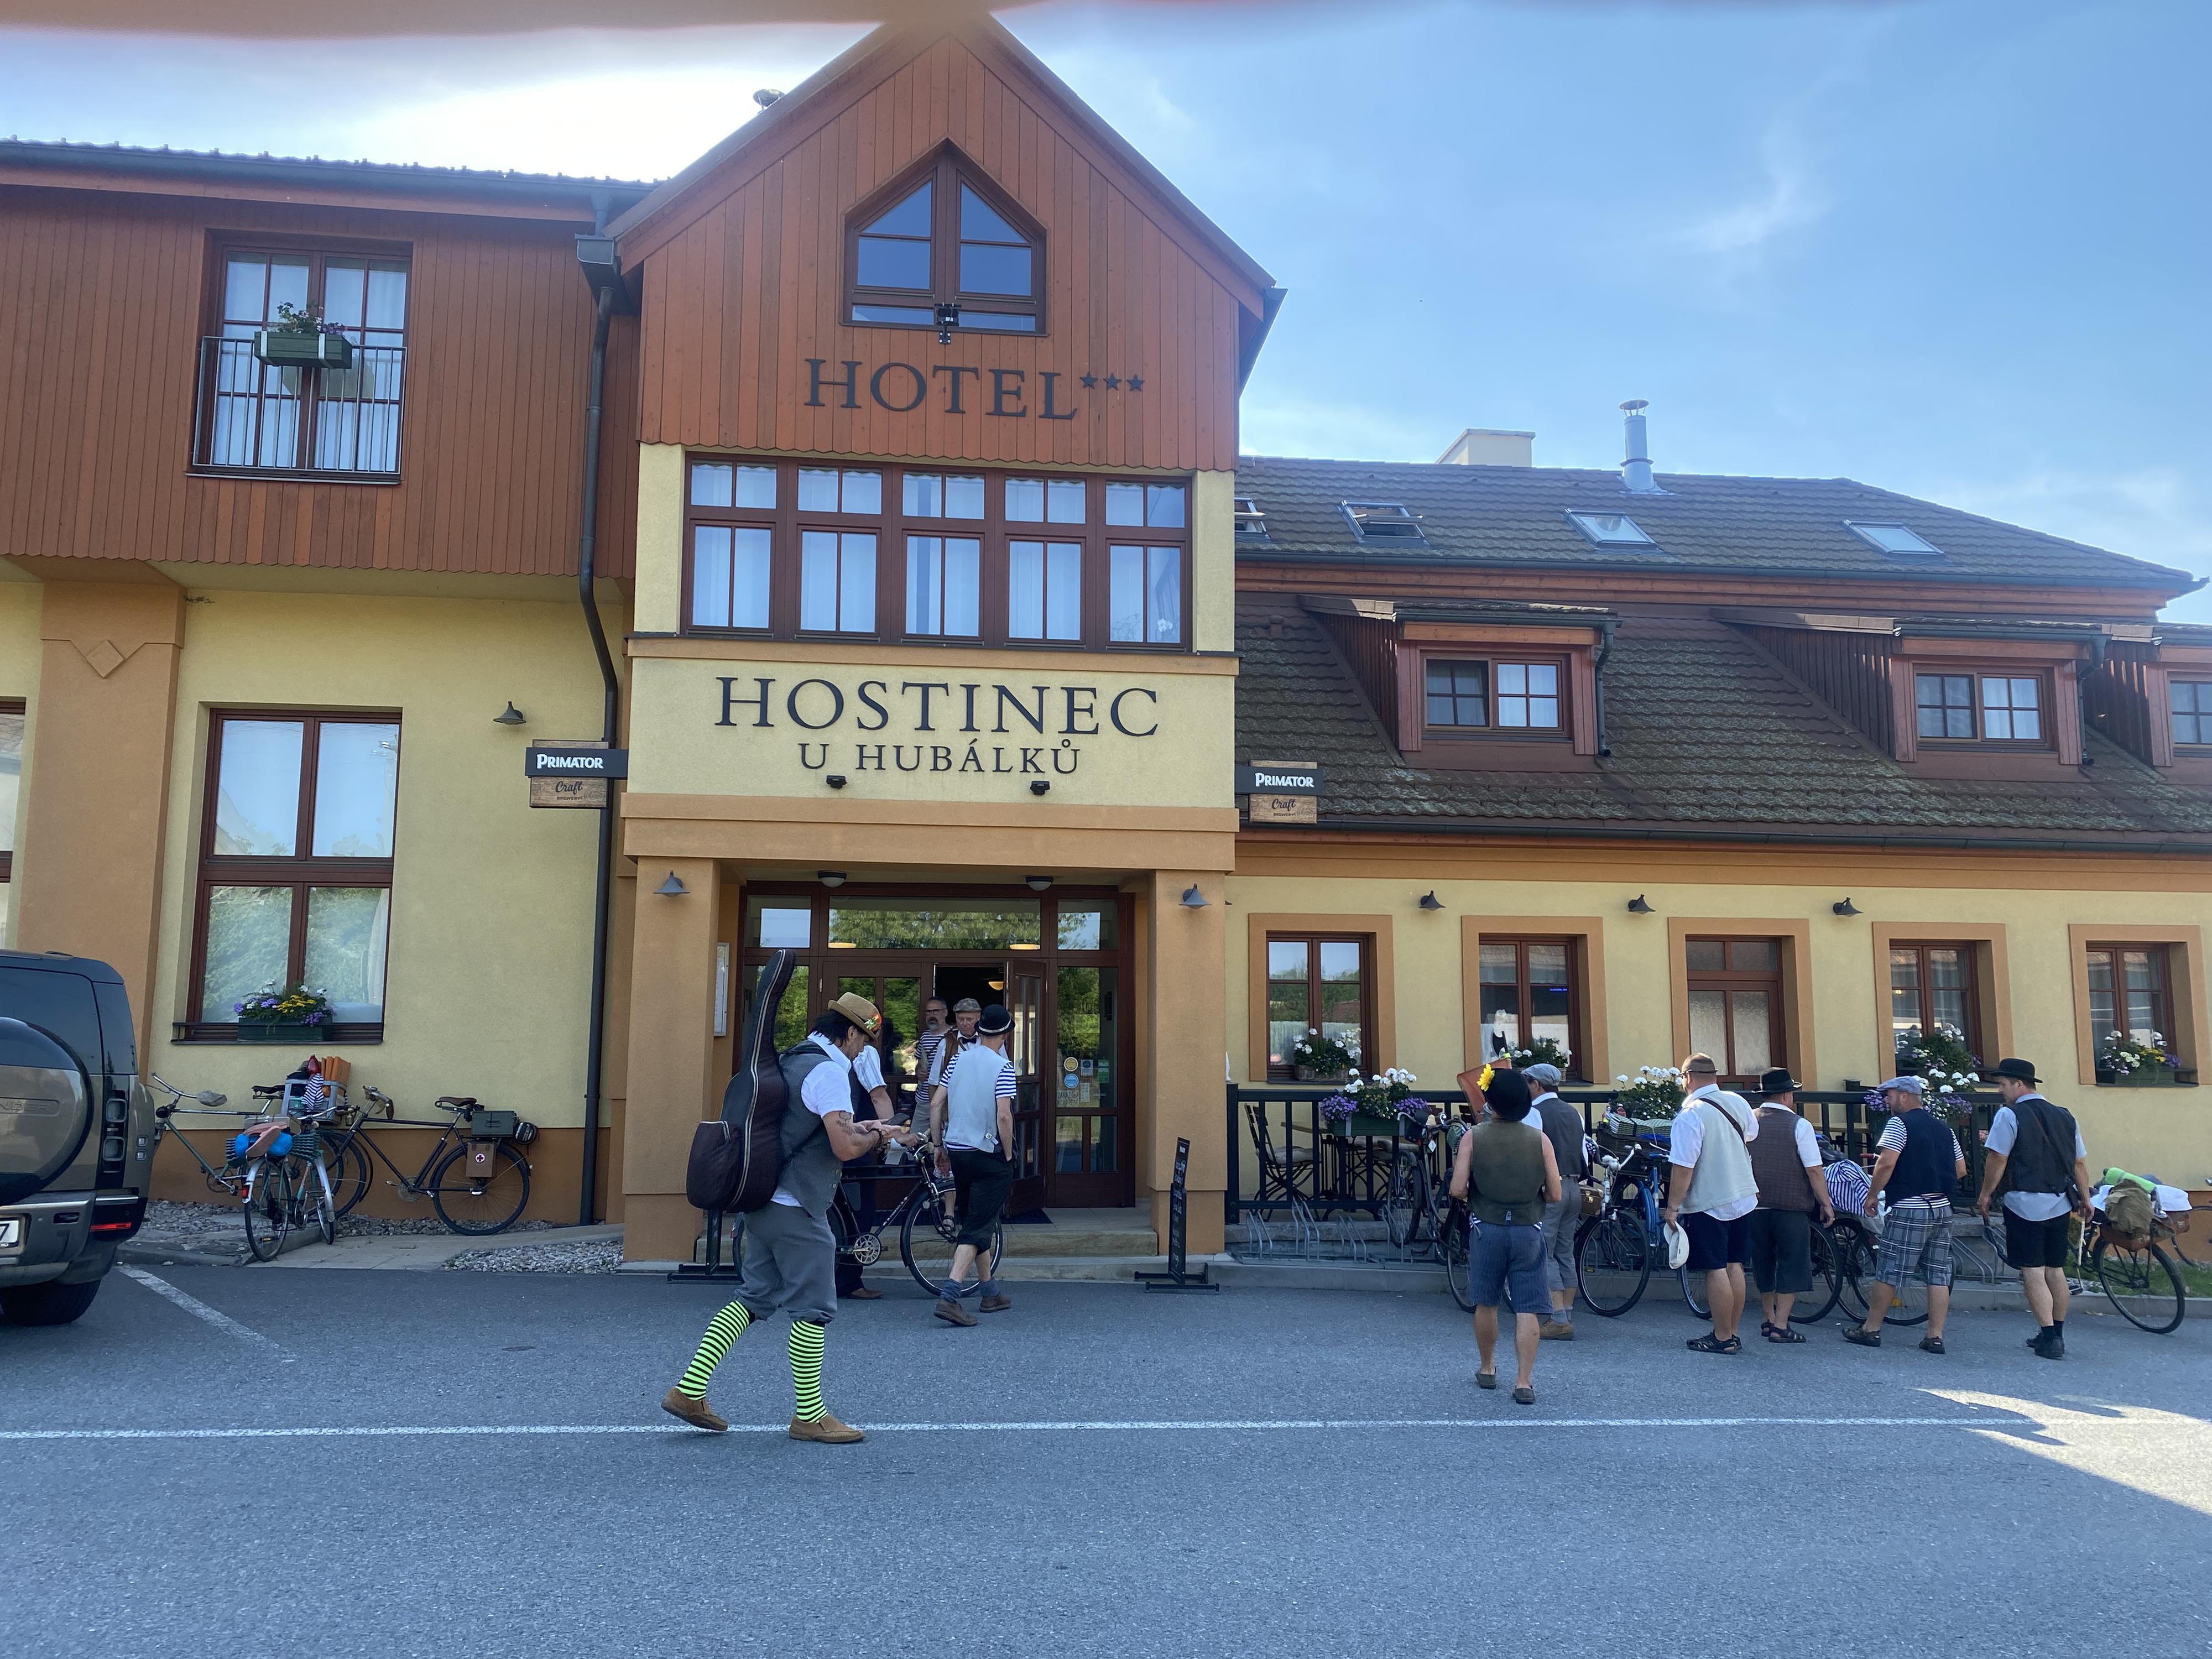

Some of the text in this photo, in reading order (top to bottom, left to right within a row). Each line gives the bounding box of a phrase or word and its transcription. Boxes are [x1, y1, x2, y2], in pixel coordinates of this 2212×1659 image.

[804, 358, 1078, 420] HOTEL
[714, 676, 1159, 737] HOSTINEC
[536, 753, 604, 769] PRIMATOR
[798, 738, 1081, 774] U HUBÁLKŮ
[555, 781, 583, 795] Craft
[1254, 772, 1315, 788] PRIMATOR
[1271, 798, 1296, 812] Craft
